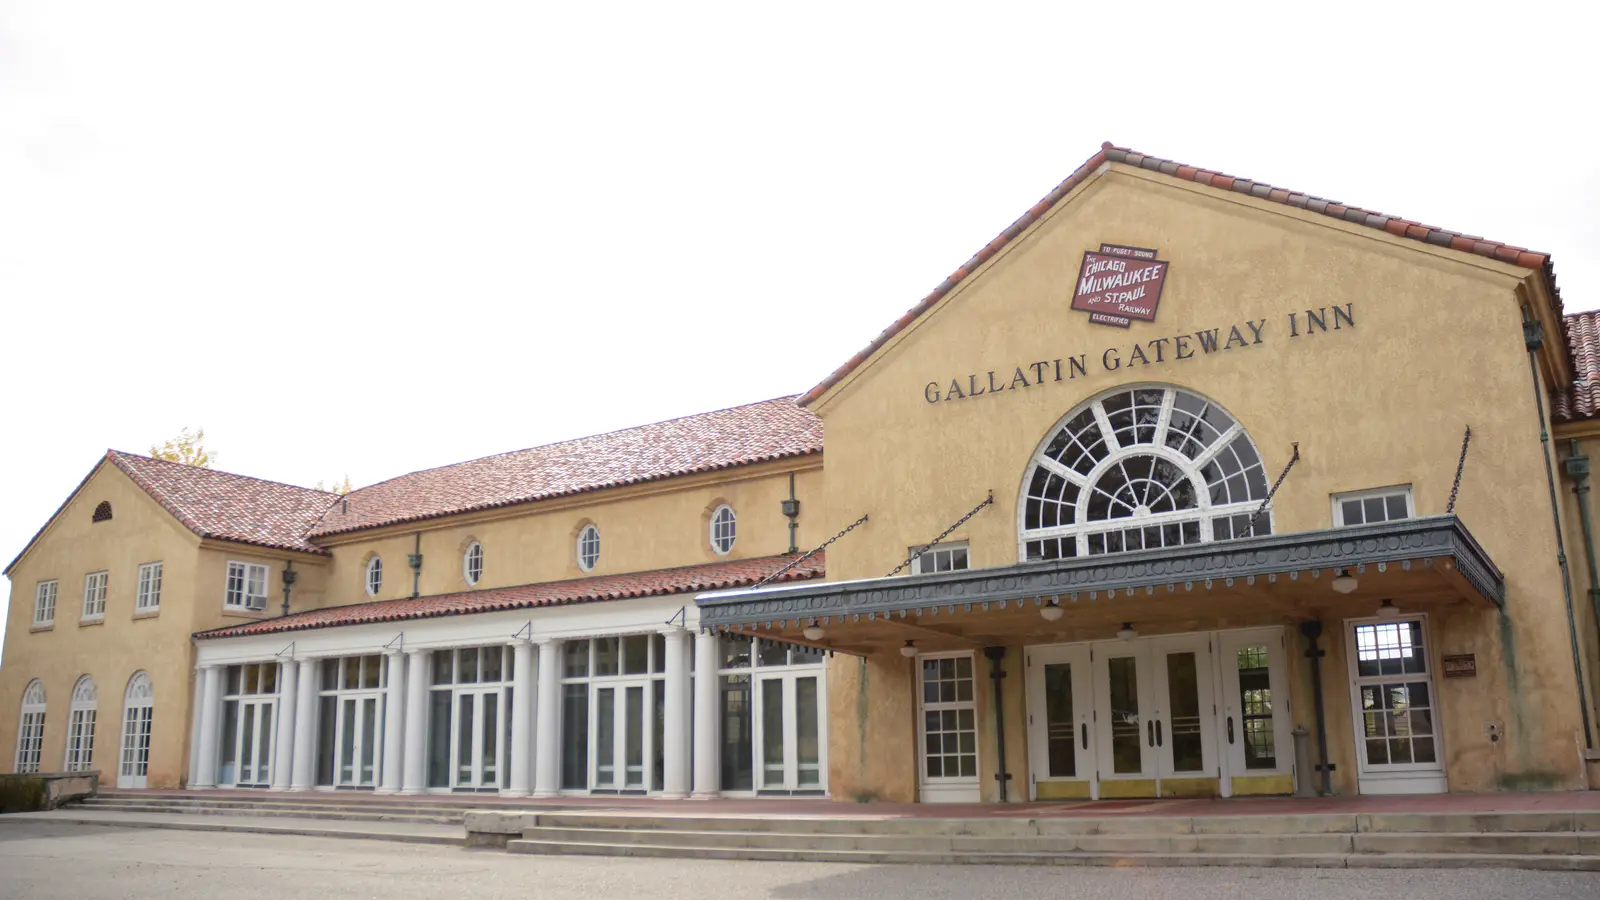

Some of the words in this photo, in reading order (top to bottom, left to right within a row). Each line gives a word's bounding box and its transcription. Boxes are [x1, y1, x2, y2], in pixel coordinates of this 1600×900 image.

[1113, 247, 1131, 256] PUGET
[1134, 250, 1153, 258] SOUND
[1085, 260, 1126, 277] CHICAGO
[1078, 264, 1162, 295] MILWAUKEE
[1088, 296, 1101, 305] AND
[1118, 303, 1151, 315] RAILWAY
[1092, 313, 1129, 325] ELECTRIFIED
[924, 354, 1087, 404] GALLATIN
[1102, 318, 1267, 371] GATEWAY
[1287, 302, 1353, 338] INN
